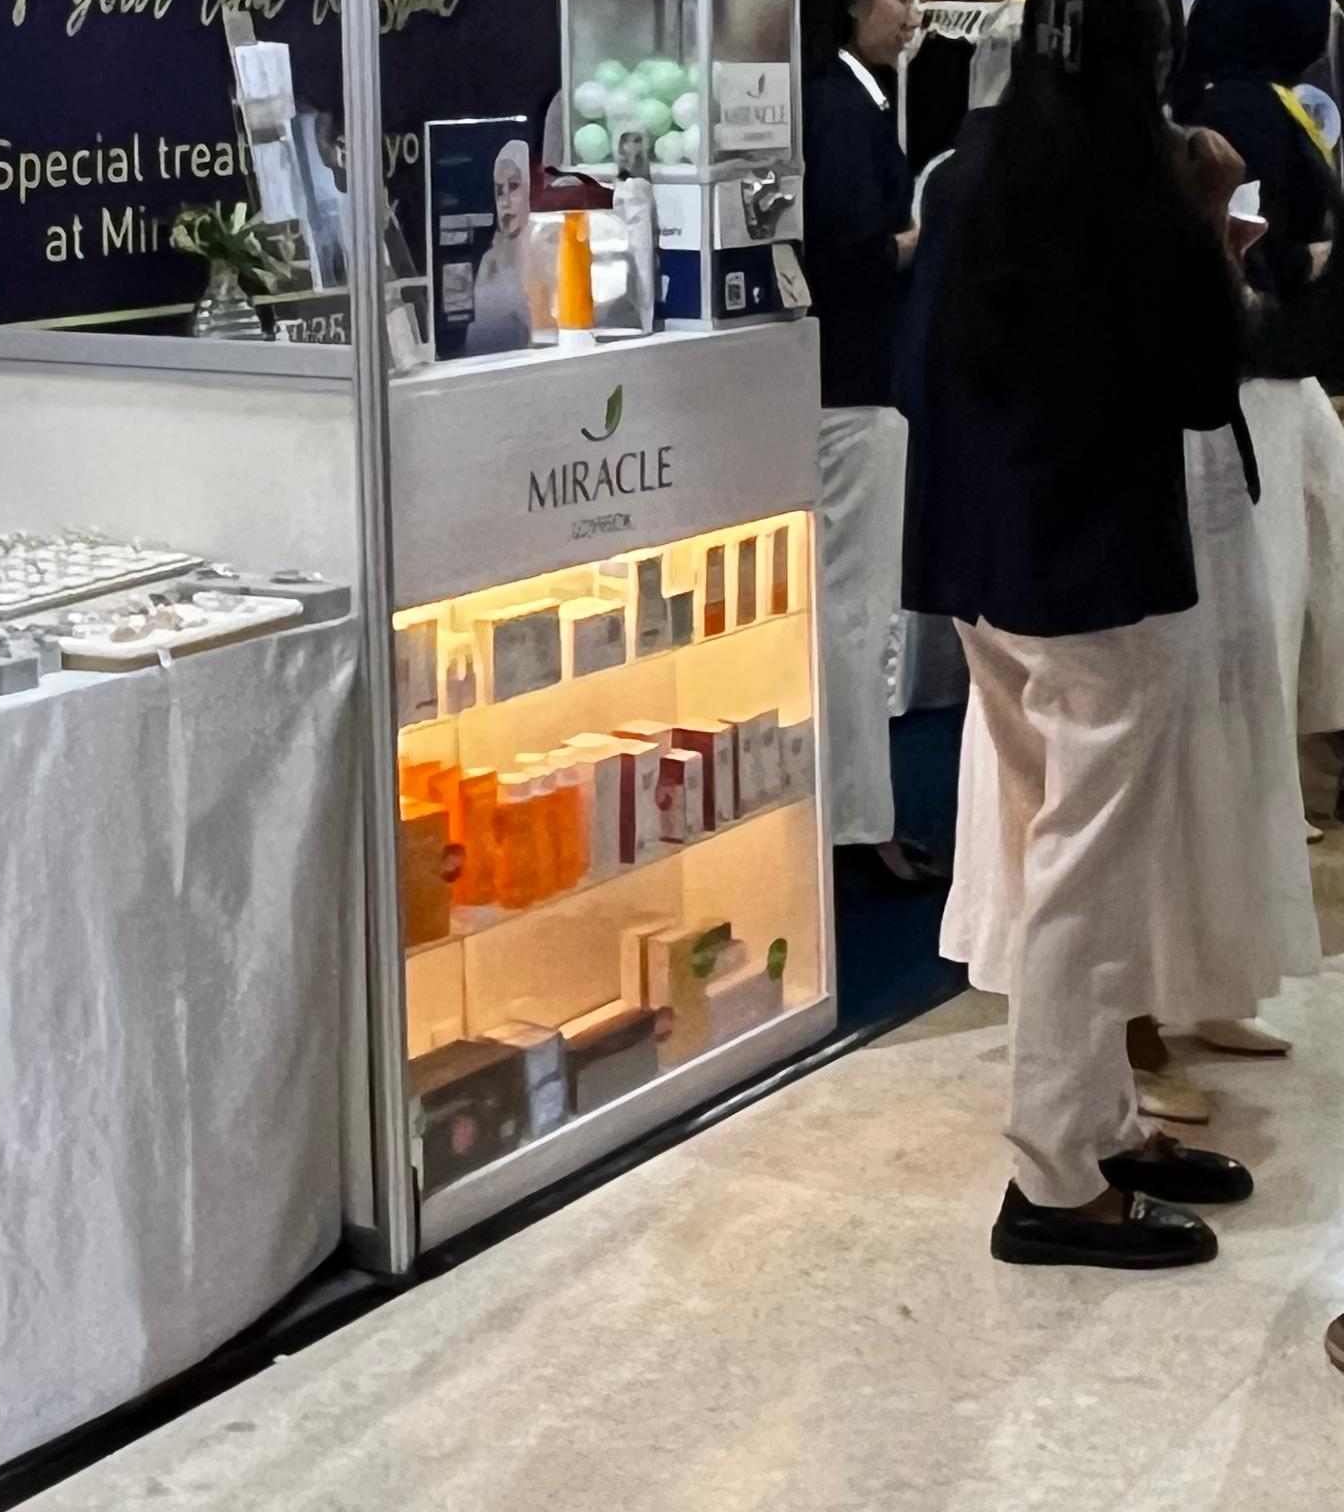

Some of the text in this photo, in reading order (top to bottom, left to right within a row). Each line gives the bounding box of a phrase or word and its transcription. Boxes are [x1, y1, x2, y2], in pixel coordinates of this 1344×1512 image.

[385, 132, 420, 178] yo
[46, 216, 84, 262] at
[528, 446, 673, 513] MIRACLE
